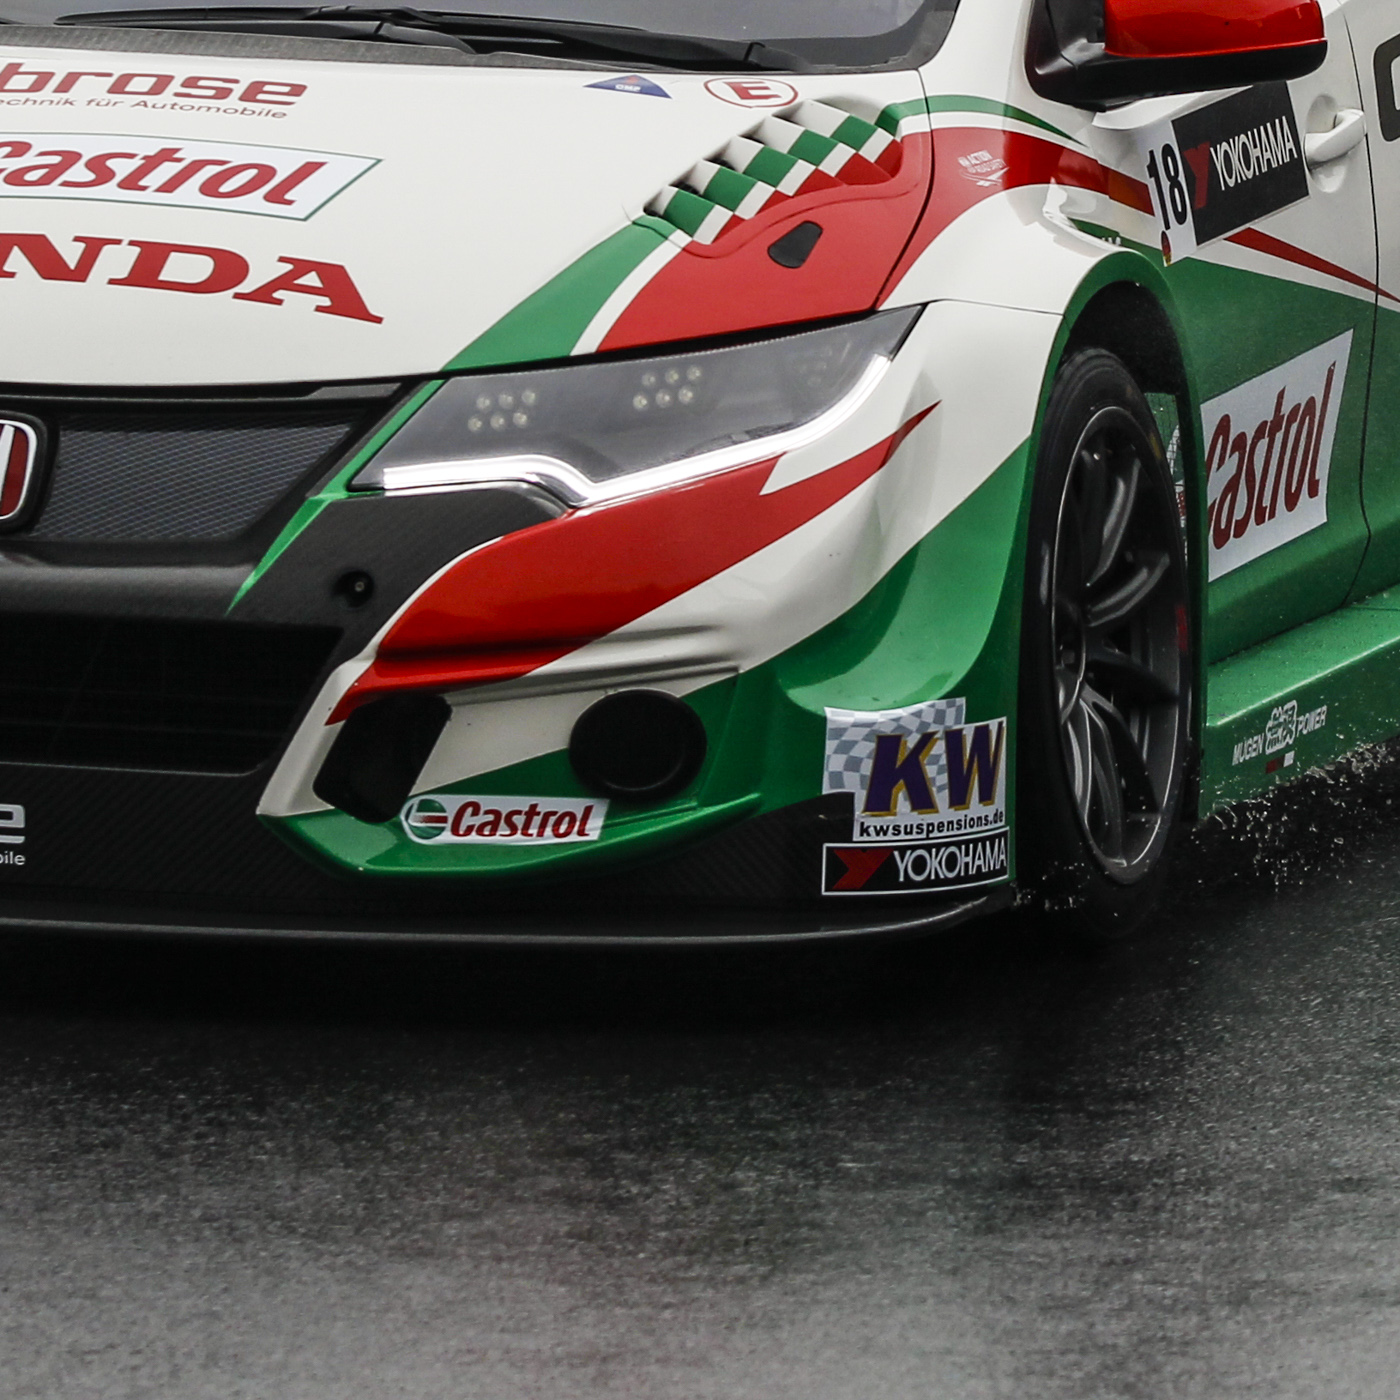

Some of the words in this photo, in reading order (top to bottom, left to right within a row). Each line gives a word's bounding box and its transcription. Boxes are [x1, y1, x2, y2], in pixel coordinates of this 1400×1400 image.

[86, 96, 126, 109] für
[130, 100, 288, 119] Automobile
[1146, 143, 1188, 231] 18
[1209, 115, 1298, 191] YOKOHAMA
[1296, 704, 1328, 738] POWER
[861, 720, 1006, 817] KW
[450, 800, 595, 839] Castrol
[858, 808, 1004, 839] kwsuspensions.de
[893, 836, 1007, 882] YOKOHAMA
